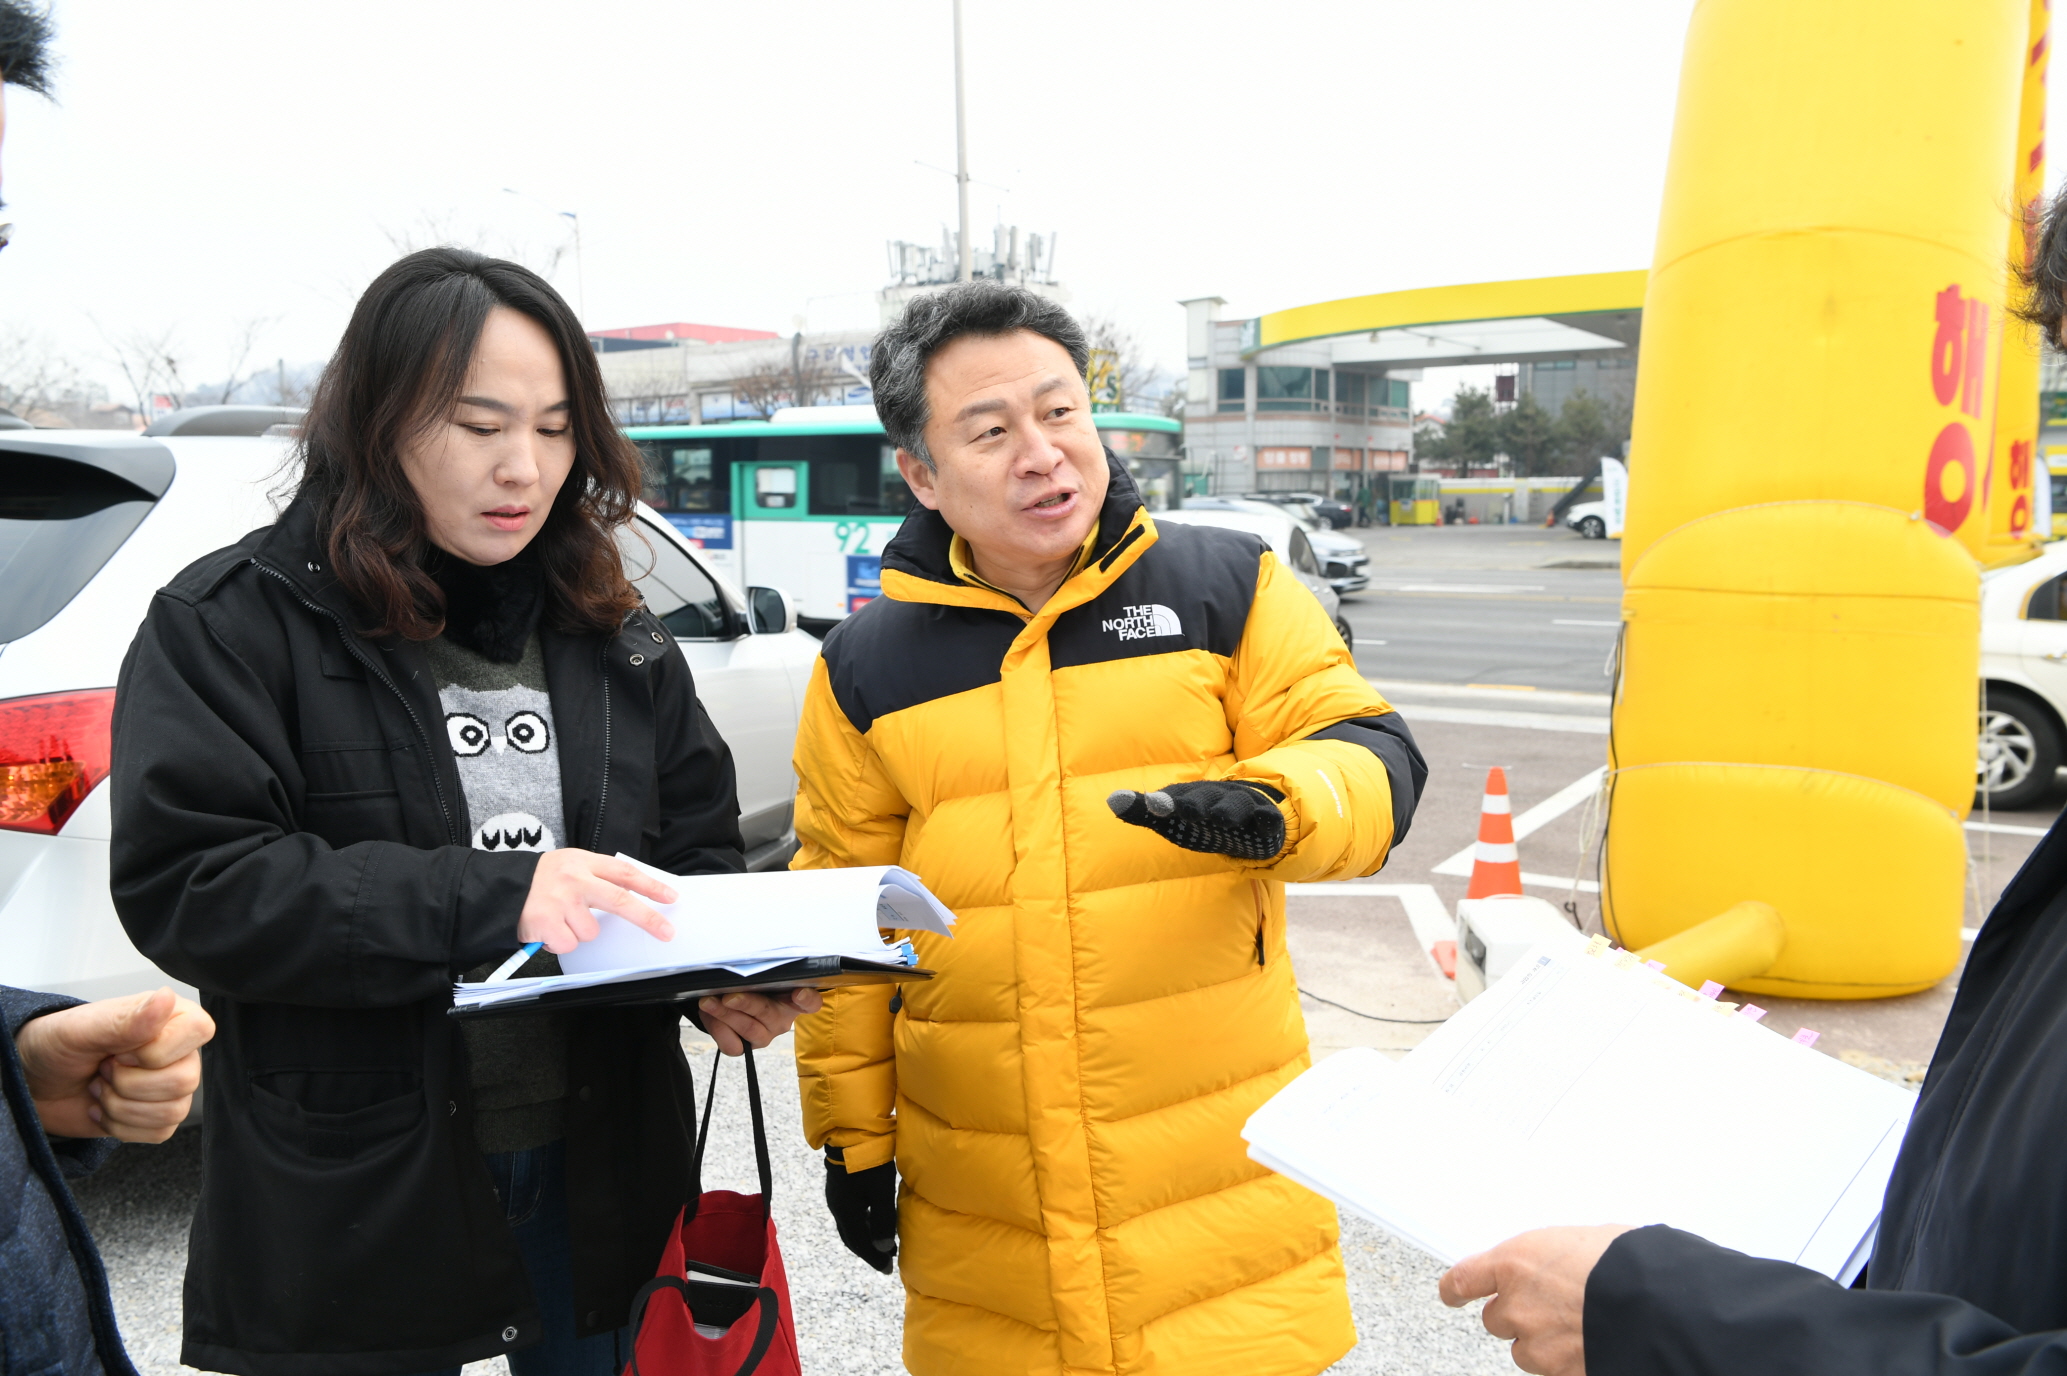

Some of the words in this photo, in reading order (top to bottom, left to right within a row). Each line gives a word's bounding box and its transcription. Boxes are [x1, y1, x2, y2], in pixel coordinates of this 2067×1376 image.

[835, 521, 870, 554] 92
[1122, 605, 1153, 617] THE
[1101, 615, 1154, 632] NORTH
[1118, 626, 1156, 641] FACE
